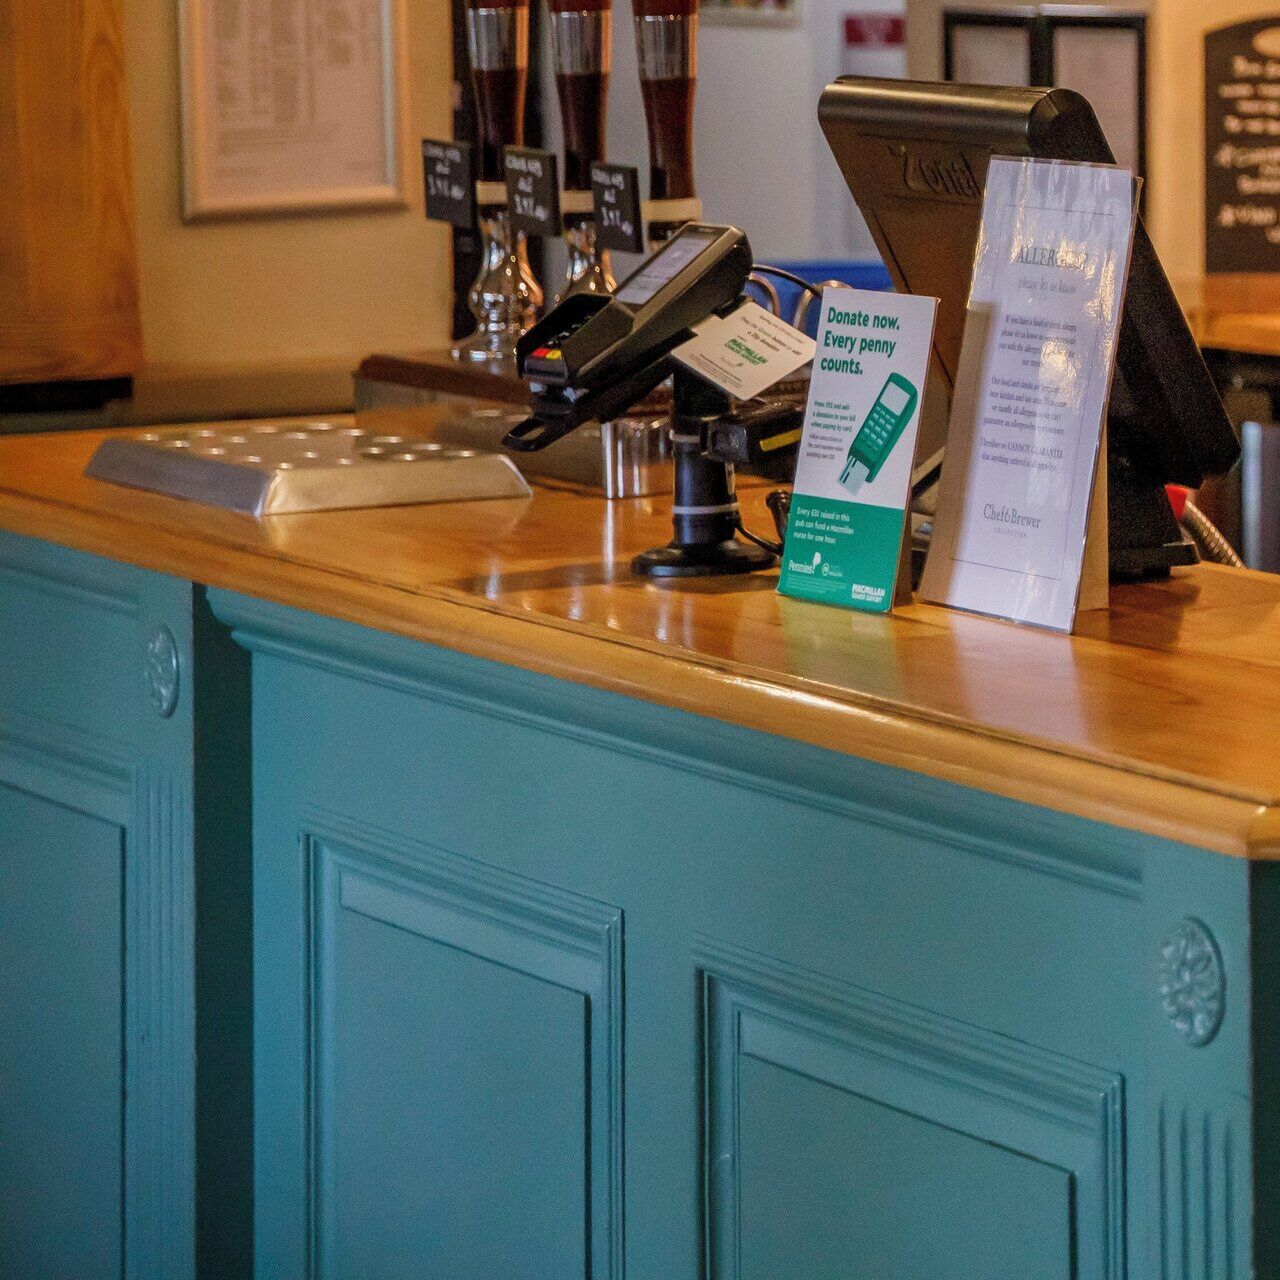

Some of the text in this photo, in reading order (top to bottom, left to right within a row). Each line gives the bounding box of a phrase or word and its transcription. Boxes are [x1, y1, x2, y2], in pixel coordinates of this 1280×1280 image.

[827, 306, 900, 330] Donate now.
[824, 330, 897, 358] Every penny
[820, 357, 863, 375] counts.
